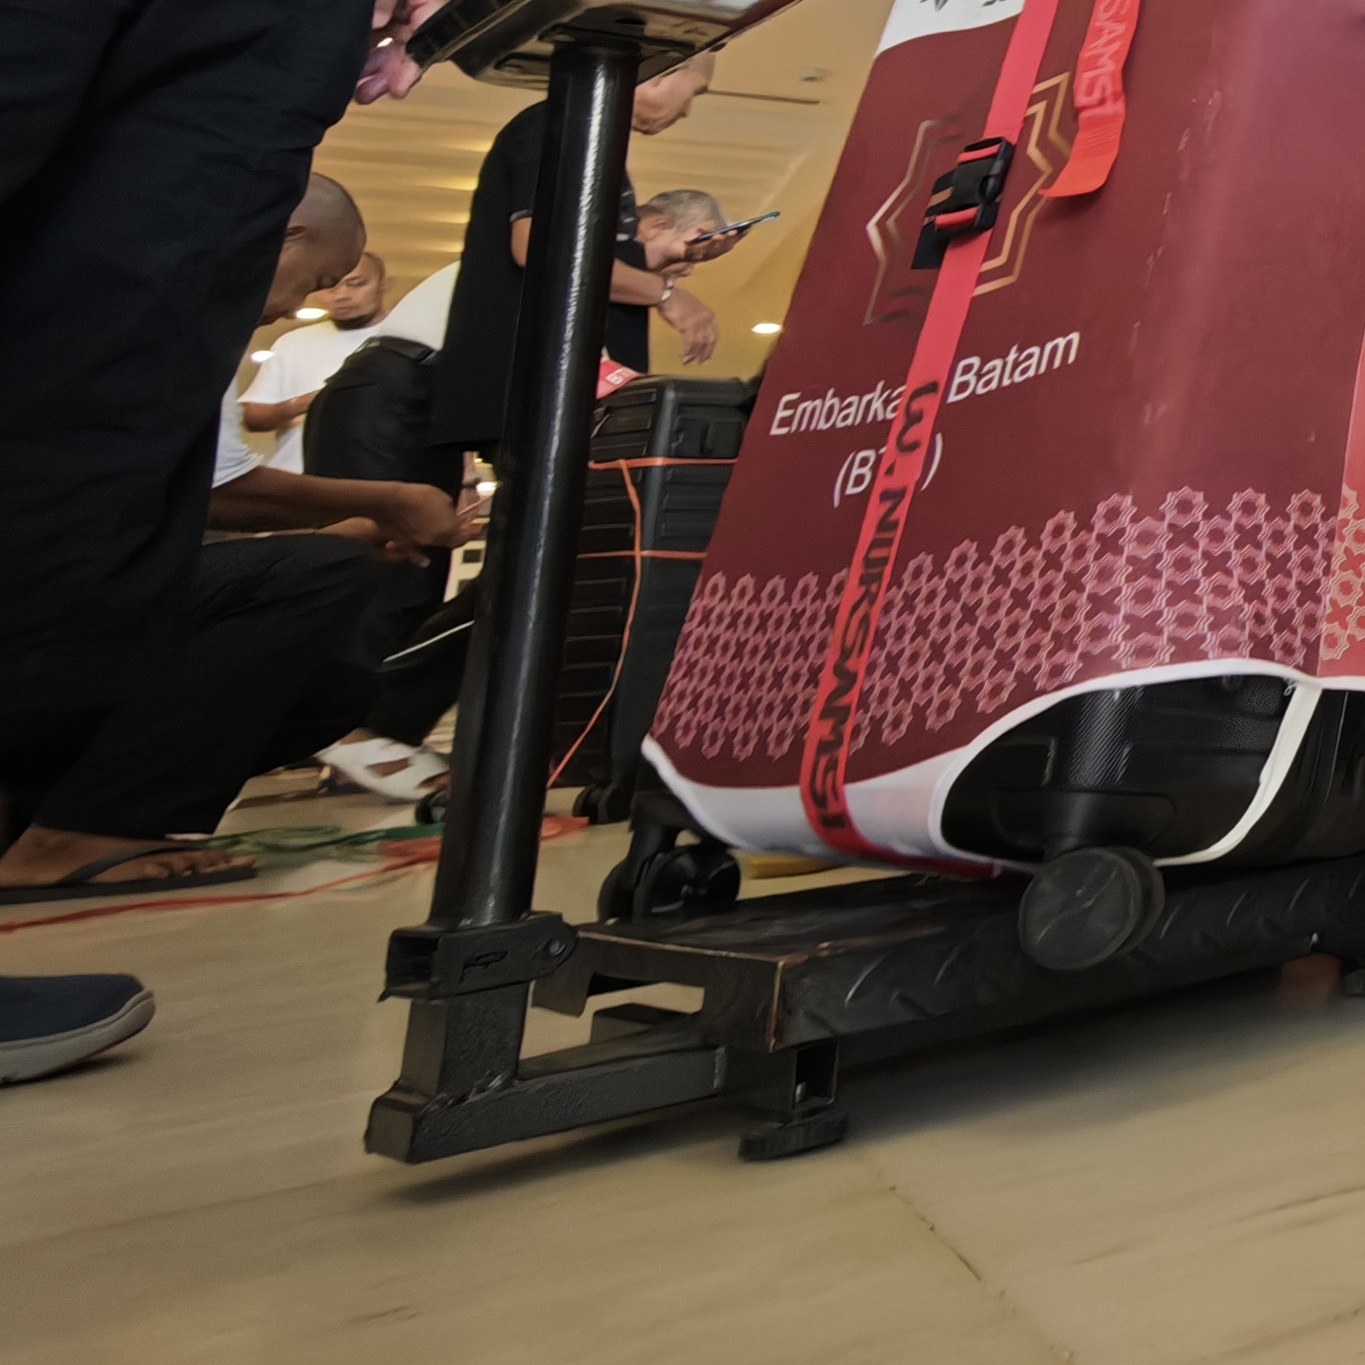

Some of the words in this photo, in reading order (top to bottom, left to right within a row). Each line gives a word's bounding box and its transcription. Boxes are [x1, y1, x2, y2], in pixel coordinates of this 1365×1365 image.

[769, 379, 908, 436] Embarka
[946, 331, 1081, 404] Batam
[833, 432, 943, 508] (B)
